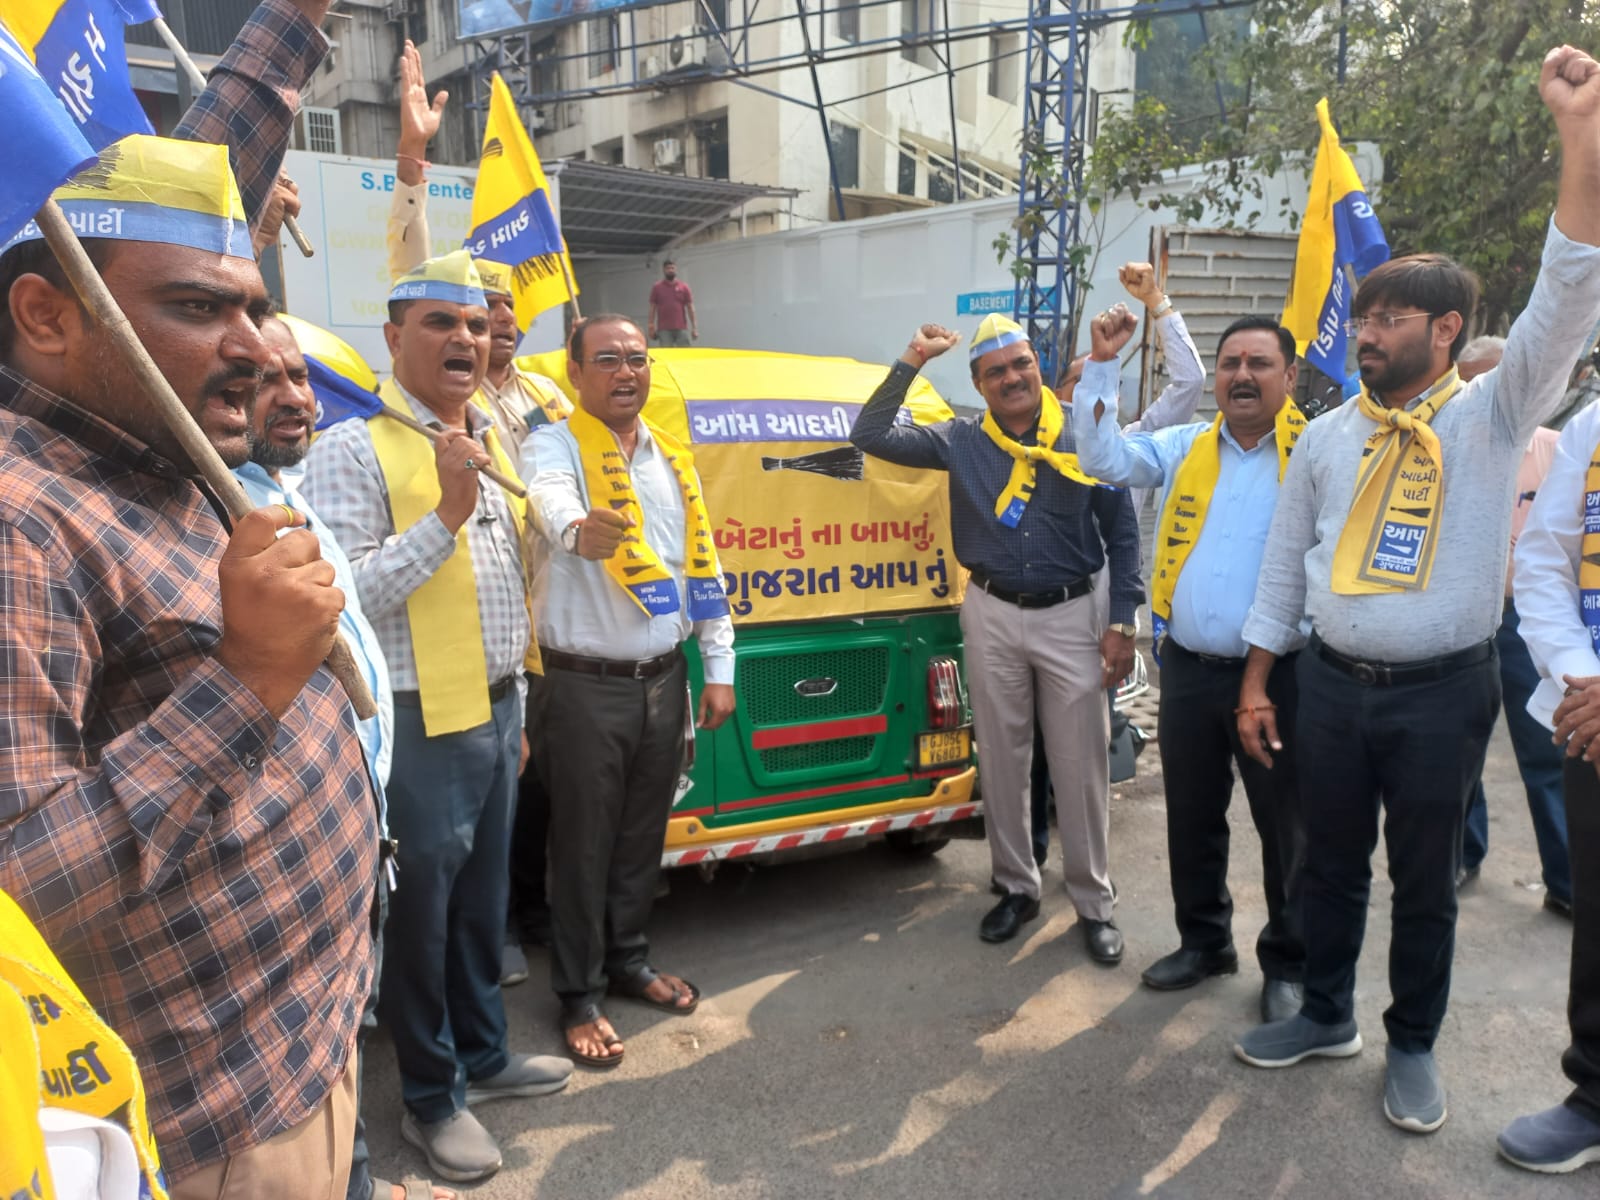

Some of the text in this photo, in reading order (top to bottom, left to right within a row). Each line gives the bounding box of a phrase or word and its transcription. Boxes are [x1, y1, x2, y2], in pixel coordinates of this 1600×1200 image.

[428, 183, 473, 200] ente
[69, 207, 125, 235] પાર્ટી
[969, 295, 1011, 311] BASEMENT
[693, 406, 849, 438] આમ આદમી
[714, 517, 805, 559] બેટાનું
[811, 523, 841, 546] ના
[722, 549, 949, 615] ગુજરાત આપ નું
